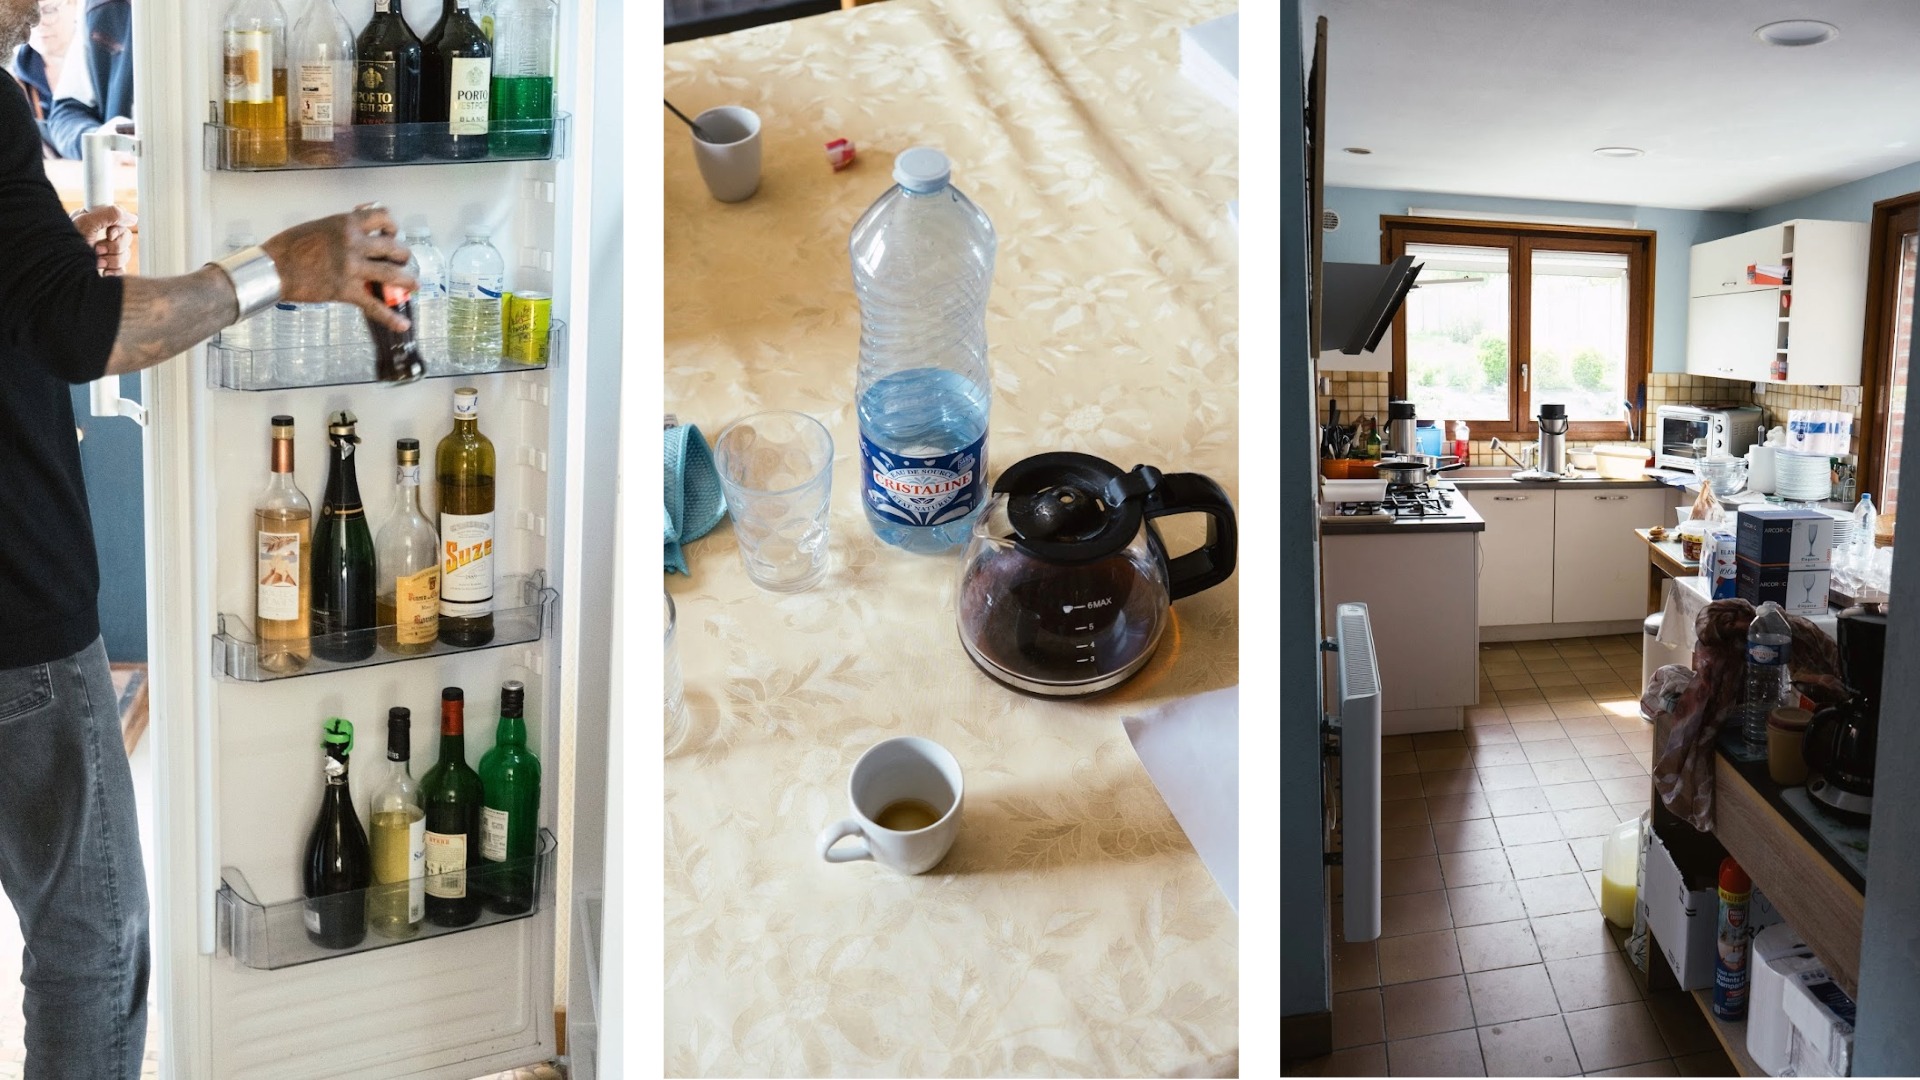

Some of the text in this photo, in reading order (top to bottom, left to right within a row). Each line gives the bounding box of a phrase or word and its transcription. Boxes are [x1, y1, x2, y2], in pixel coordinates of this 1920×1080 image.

[357, 92, 392, 104] PORTO
[457, 90, 488, 101] PORTO
[890, 468, 906, 478] EAU
[921, 468, 953, 478] SOURCE
[875, 472, 971, 495] CRISTALINE
[914, 494, 953, 512] NATUREL
[445, 538, 493, 575] Suze
[1088, 623, 1095, 631] 5
[1716, 972, 1740, 983] Volants
